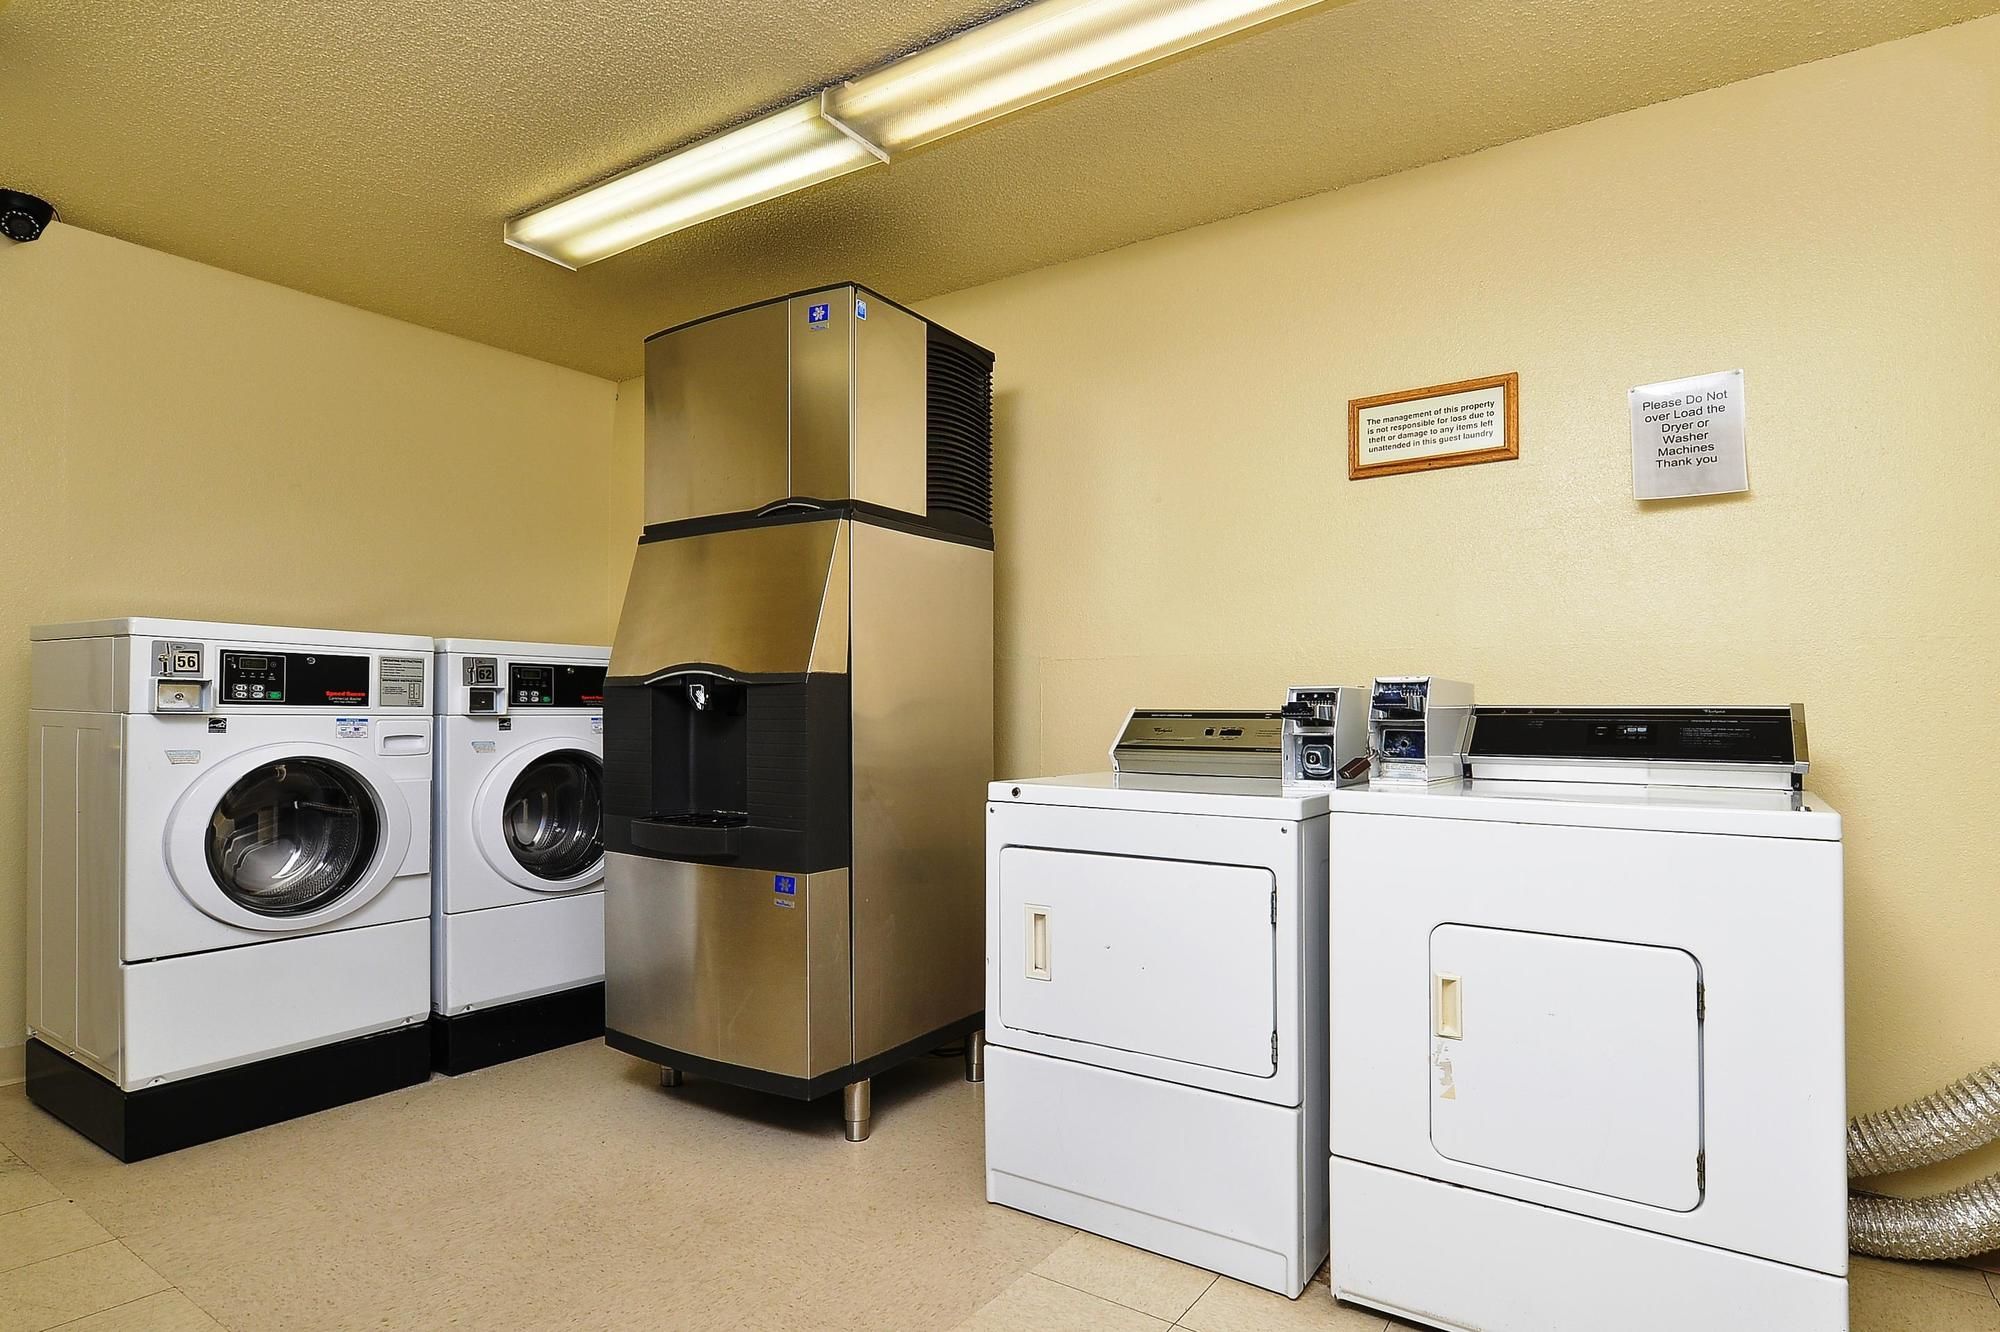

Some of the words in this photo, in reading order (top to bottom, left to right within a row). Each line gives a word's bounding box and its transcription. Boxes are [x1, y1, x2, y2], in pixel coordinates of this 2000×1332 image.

[1642, 398, 1682, 411] Please
[1686, 394, 1703, 405] Do
[1706, 390, 1728, 401] Not
[1367, 418, 1381, 426] The
[1383, 410, 1432, 423] management
[1433, 408, 1442, 416] of
[1443, 406, 1459, 414] this
[1461, 401, 1495, 413] property
[1644, 412, 1671, 423] over
[1673, 406, 1703, 419] Load
[1707, 404, 1726, 415] the
[1376, 425, 1389, 434] not
[1390, 419, 1436, 432] responsible
[1437, 416, 1449, 425] for
[1450, 415, 1467, 423] loss
[1468, 412, 1485, 420] due
[1661, 421, 1694, 433] Dryer
[1697, 419, 1710, 428] or
[1368, 435, 1386, 444] theft
[1397, 430, 1428, 440] damage
[1439, 425, 1455, 435] any
[1456, 422, 1479, 431] items
[1480, 420, 1493, 428] left
[1662, 431, 1709, 445] Washer
[1368, 440, 1411, 453] unattended
[1412, 439, 1421, 447] in
[1422, 436, 1437, 445] this
[1438, 434, 1461, 445] guest
[1462, 429, 1494, 440] laundry
[1657, 443, 1715, 457] Machines
[1656, 456, 1692, 469] Thank
[1696, 455, 1718, 467] you
[177, 656, 196, 668] 56
[479, 669, 492, 680] 62
